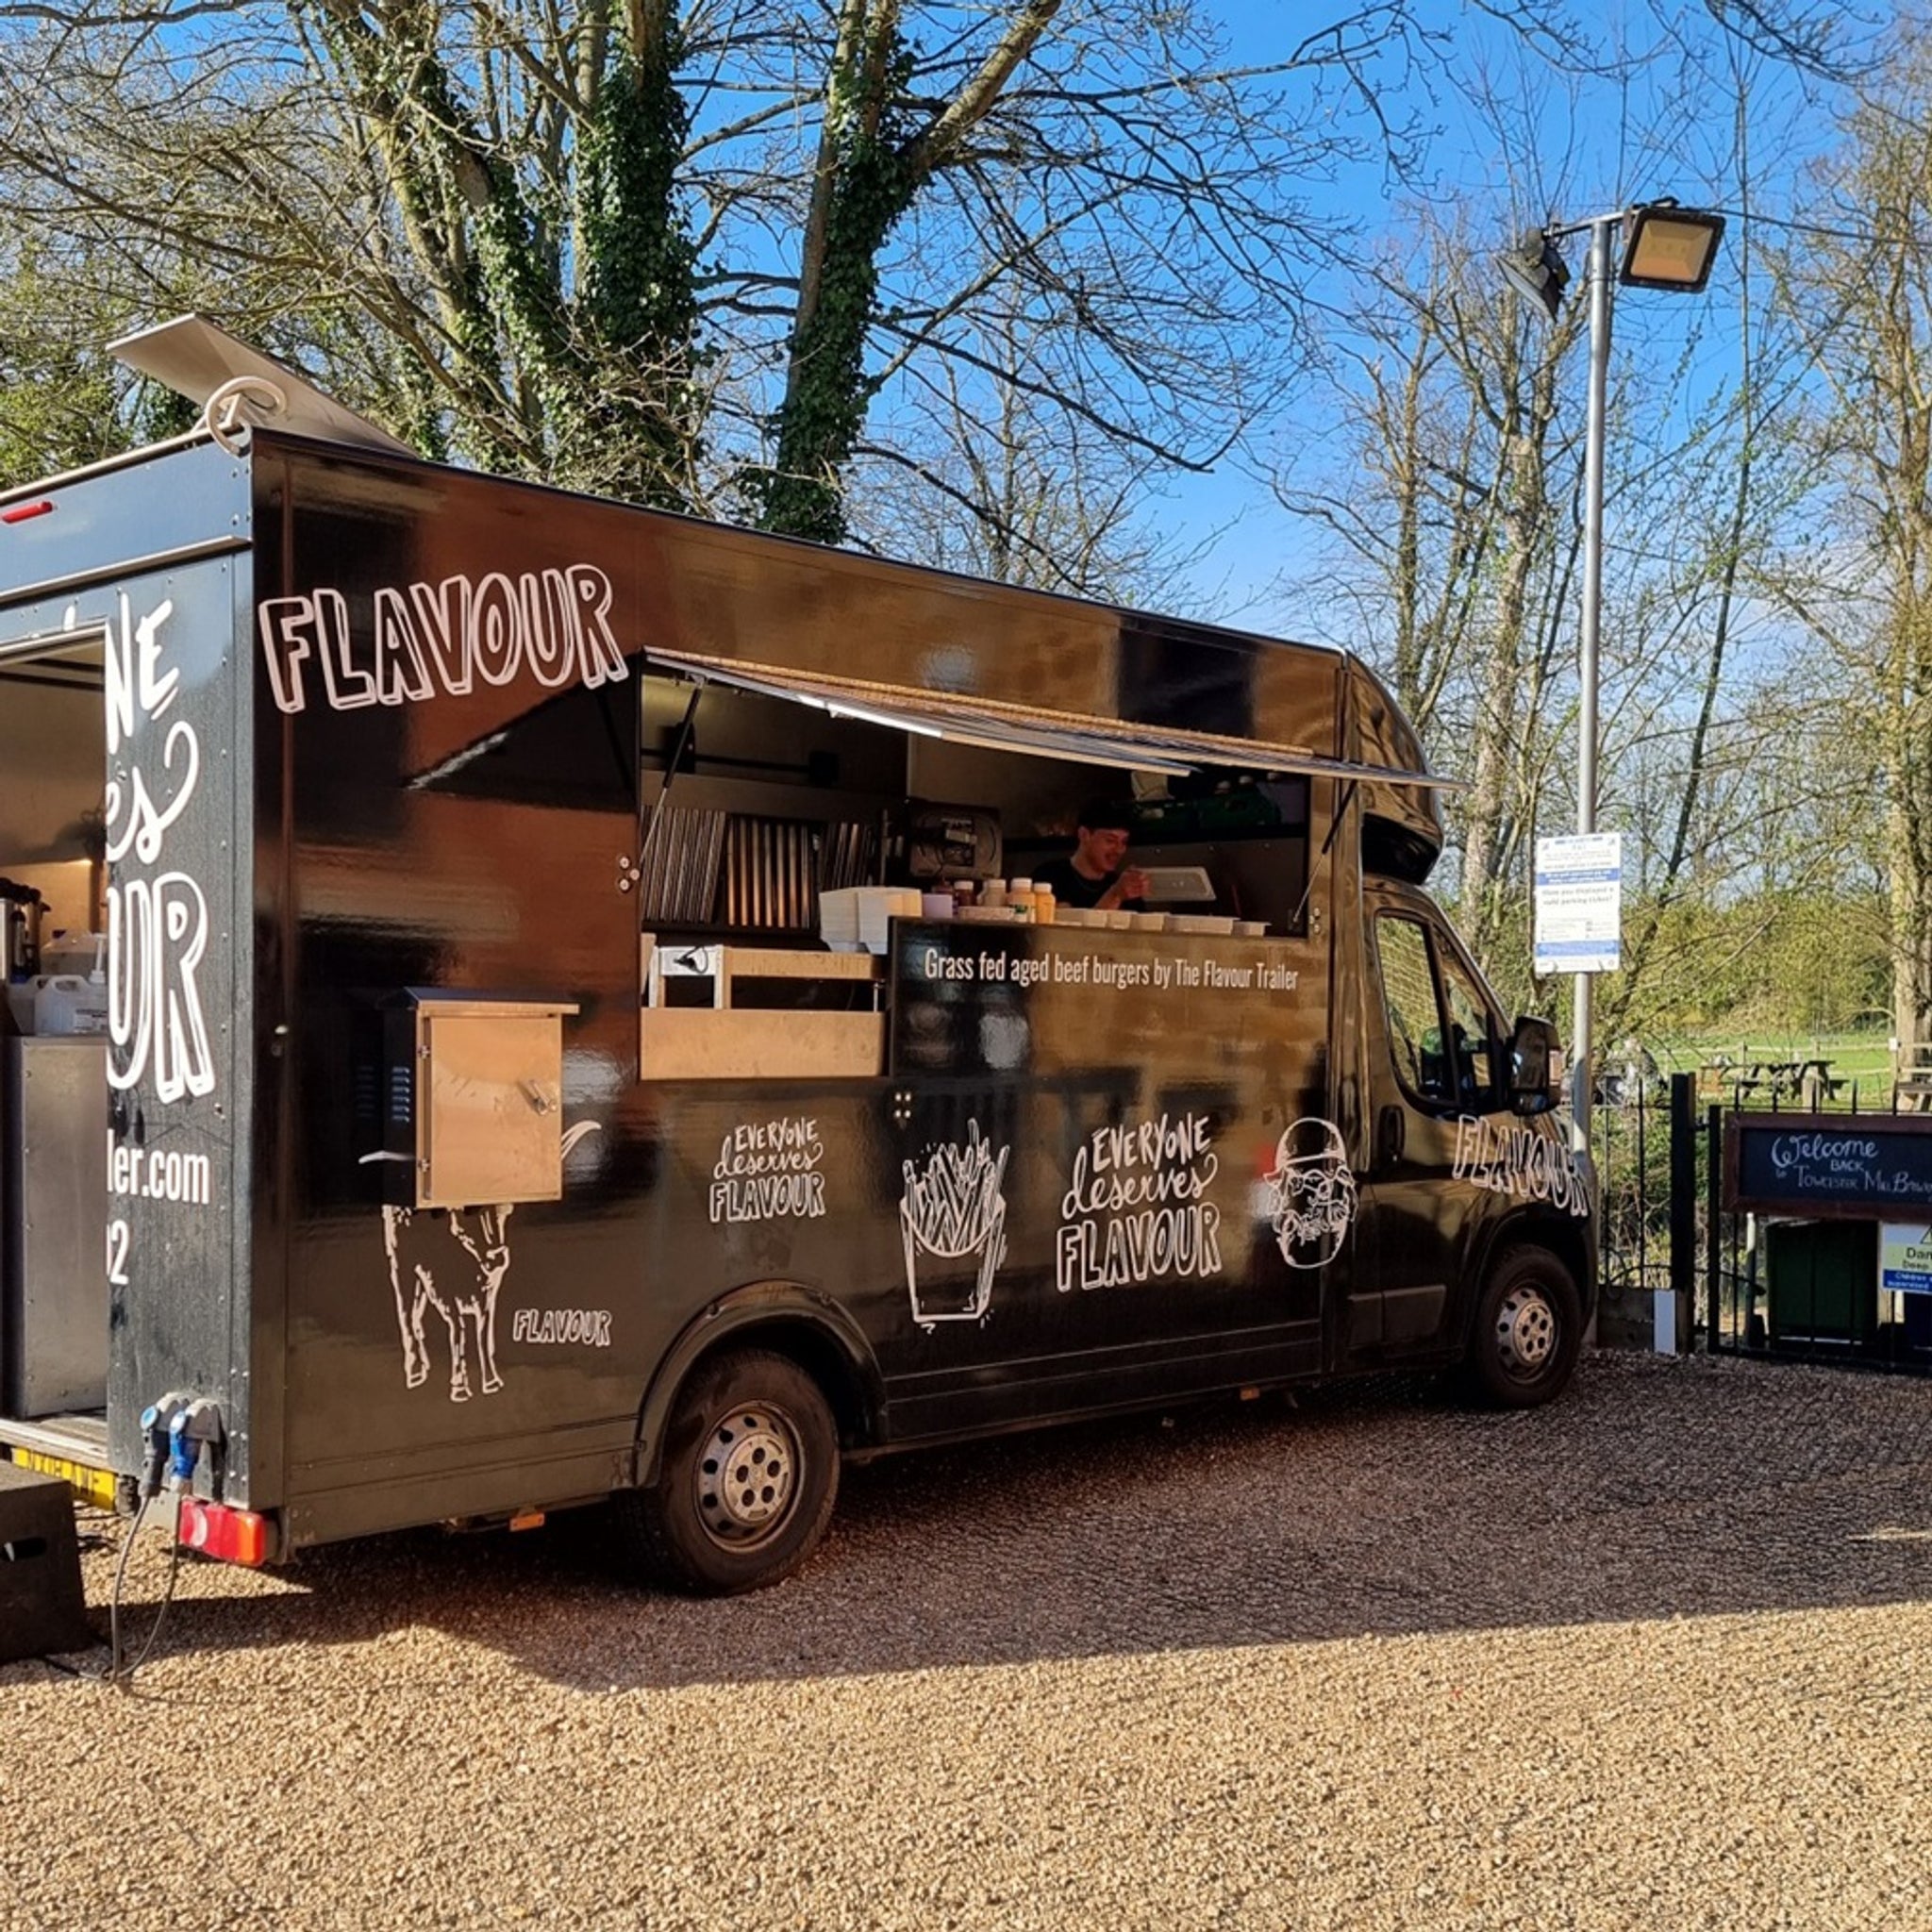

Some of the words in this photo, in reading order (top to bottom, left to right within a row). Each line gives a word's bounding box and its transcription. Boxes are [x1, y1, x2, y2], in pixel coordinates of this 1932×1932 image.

[258, 564, 630, 713] FLAVOUR
[924, 947, 974, 980] Grass
[978, 950, 1007, 981] fed
[1010, 952, 1050, 988] aged
[1054, 953, 1090, 983] beef
[1092, 955, 1150, 990] burgers
[1153, 958, 1173, 990] by
[1174, 958, 1200, 988] The
[1204, 958, 1253, 989] Flavour
[1256, 961, 1300, 991] Trailer
[107, 1128, 209, 1205] ler.com
[713, 1135, 824, 1179] deserves
[1451, 1114, 1589, 1217] FLAVOUR
[1771, 1133, 1879, 1168] Welcome
[1830, 1158, 1865, 1173] BACK
[709, 1171, 826, 1223] FLAVOUR
[1062, 1145, 1219, 1221] deserves
[107, 1219, 130, 1285] 2
[1057, 1201, 1223, 1292] FLAVOUR
[512, 1307, 612, 1348] FLAVOUR
